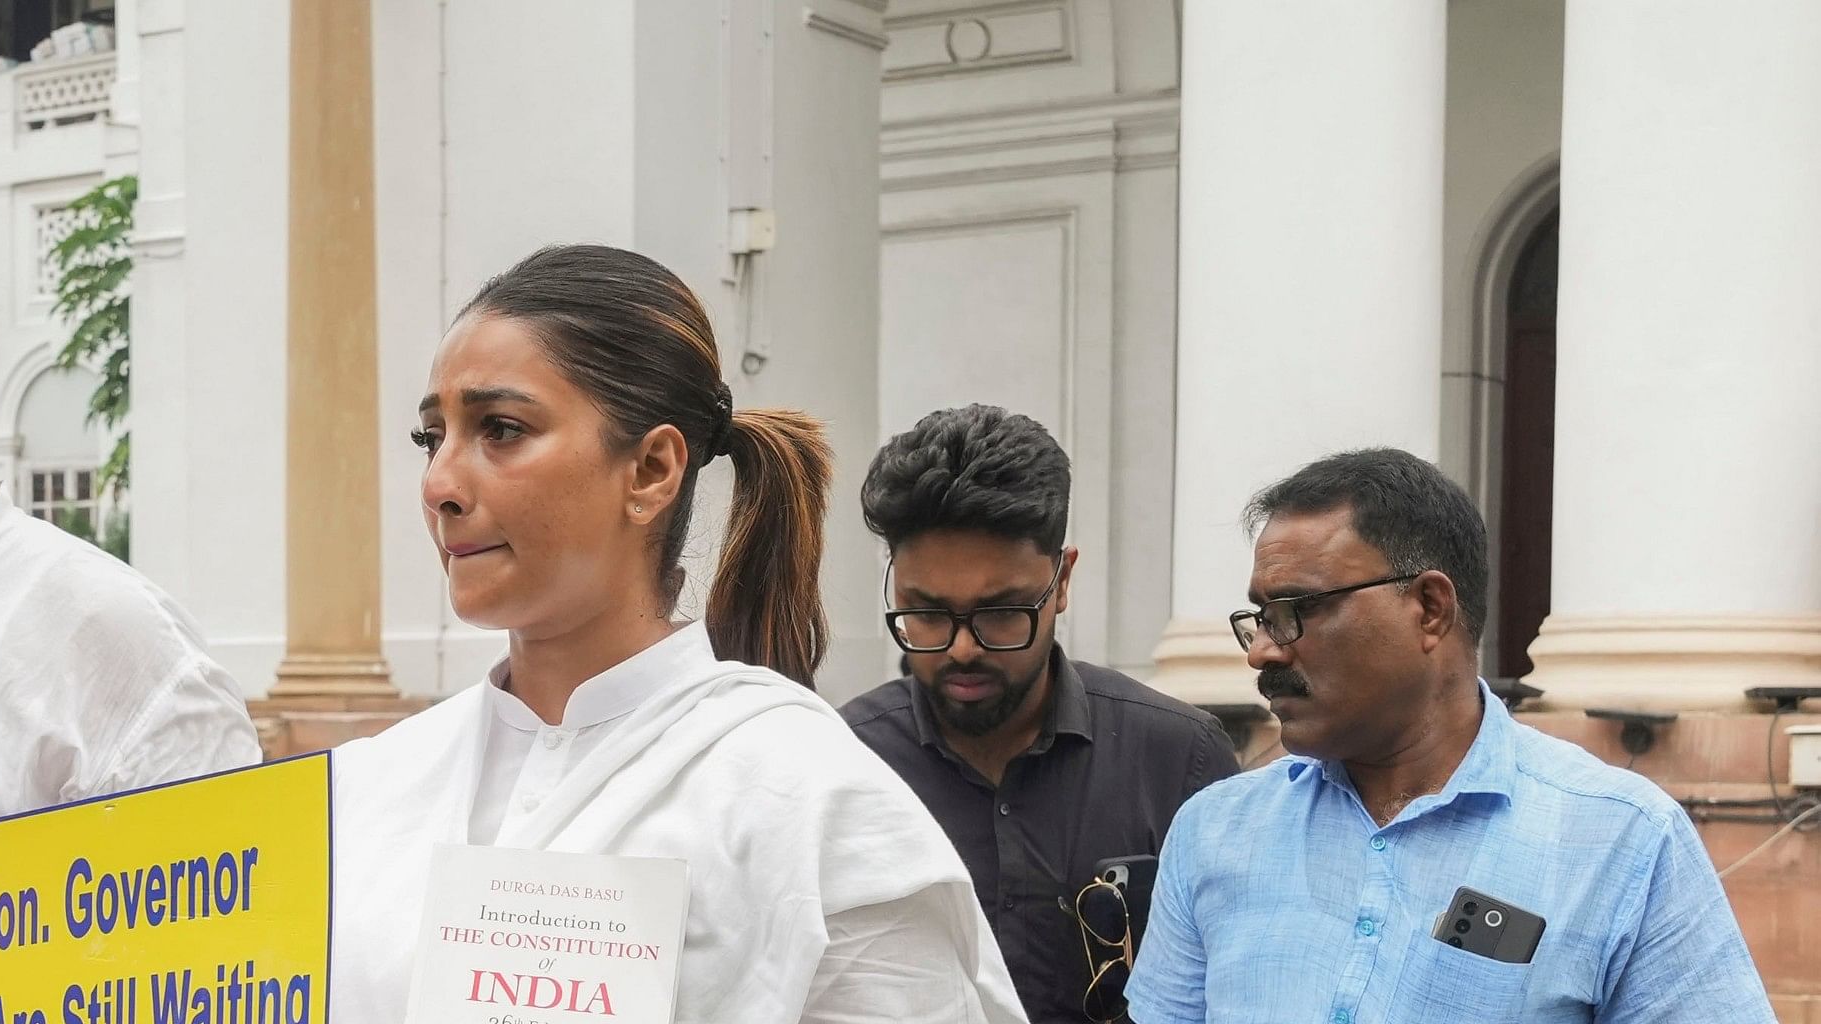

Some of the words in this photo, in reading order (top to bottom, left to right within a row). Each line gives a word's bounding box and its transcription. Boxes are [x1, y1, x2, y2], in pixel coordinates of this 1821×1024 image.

[65, 846, 259, 940] Governor
[490, 879, 545, 896] DURGA
[549, 884, 580, 899] DAS
[584, 887, 625, 902] BASU
[479, 904, 601, 931] Introduction
[608, 919, 627, 934] to
[440, 925, 485, 945] THE
[490, 930, 661, 961] CONSTITUTION
[538, 957, 557, 973] Of
[466, 969, 616, 1017] INDIA
